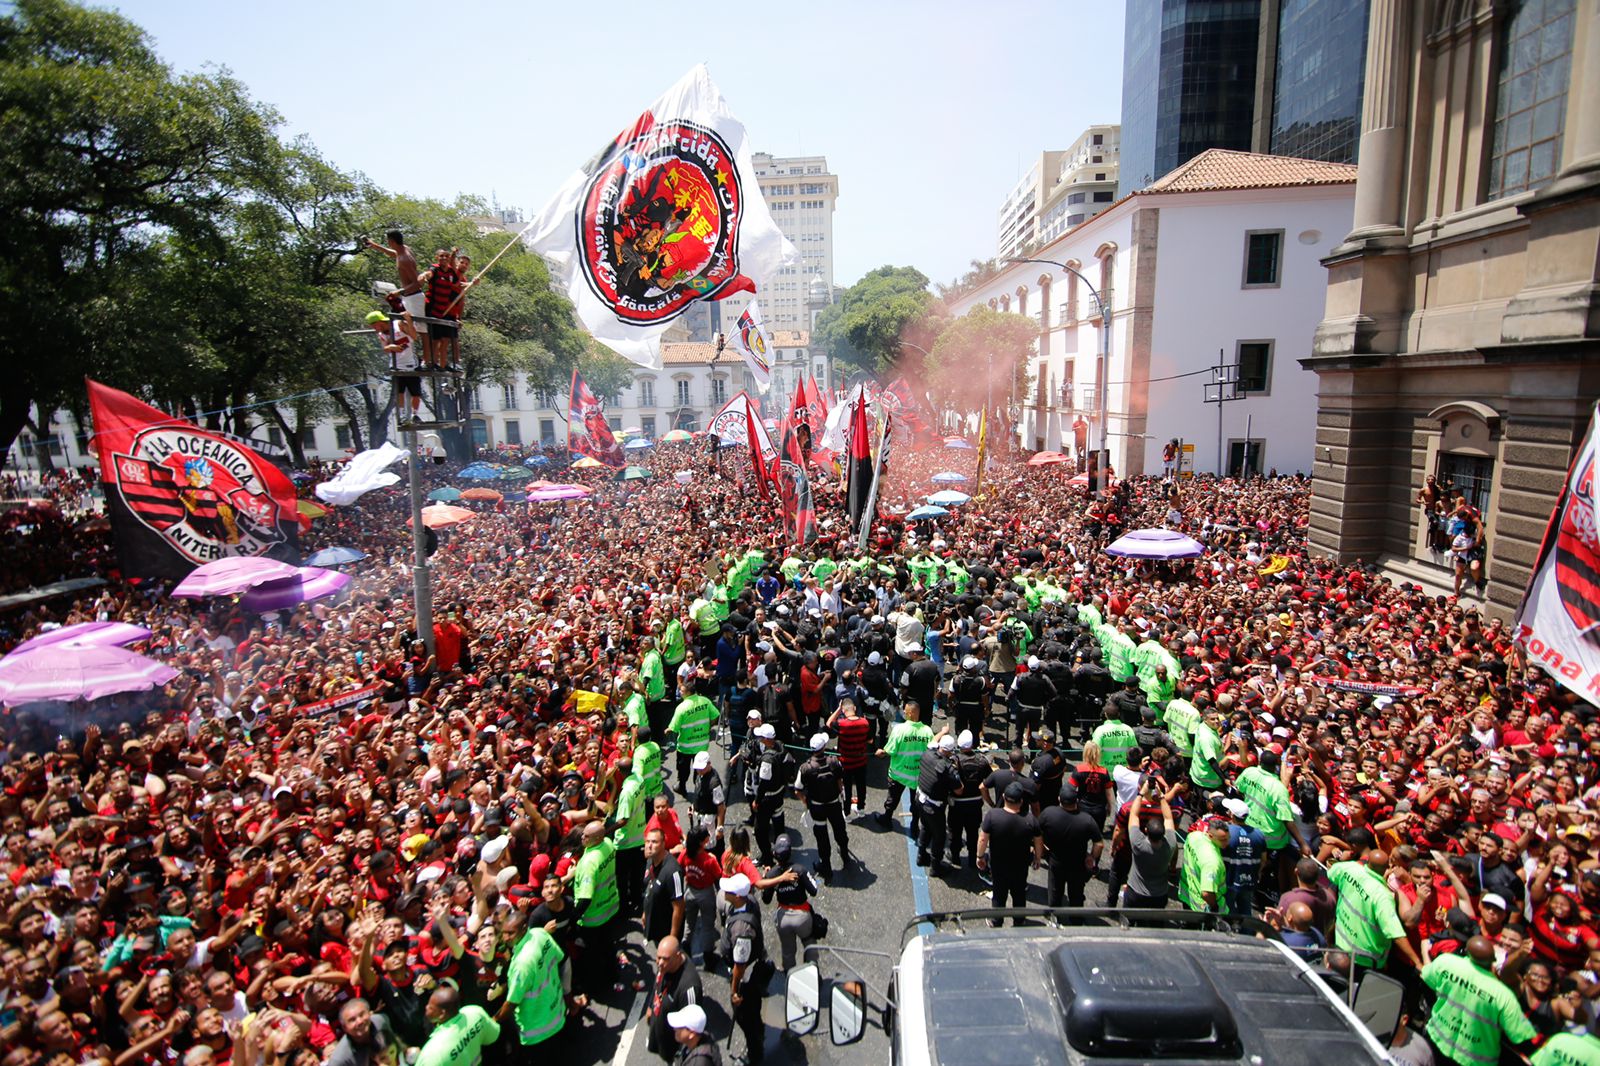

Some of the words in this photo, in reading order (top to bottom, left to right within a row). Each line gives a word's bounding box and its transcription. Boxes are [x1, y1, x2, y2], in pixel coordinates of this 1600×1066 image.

[234, 539, 260, 558] RJ
[1516, 623, 1583, 681] Zona
[686, 704, 709, 715] SUNSET
[1102, 730, 1130, 738] SUNSET
[1243, 777, 1267, 794] SUNSET
[1343, 872, 1370, 902] SUNSET
[1440, 969, 1497, 1004] SUNSET
